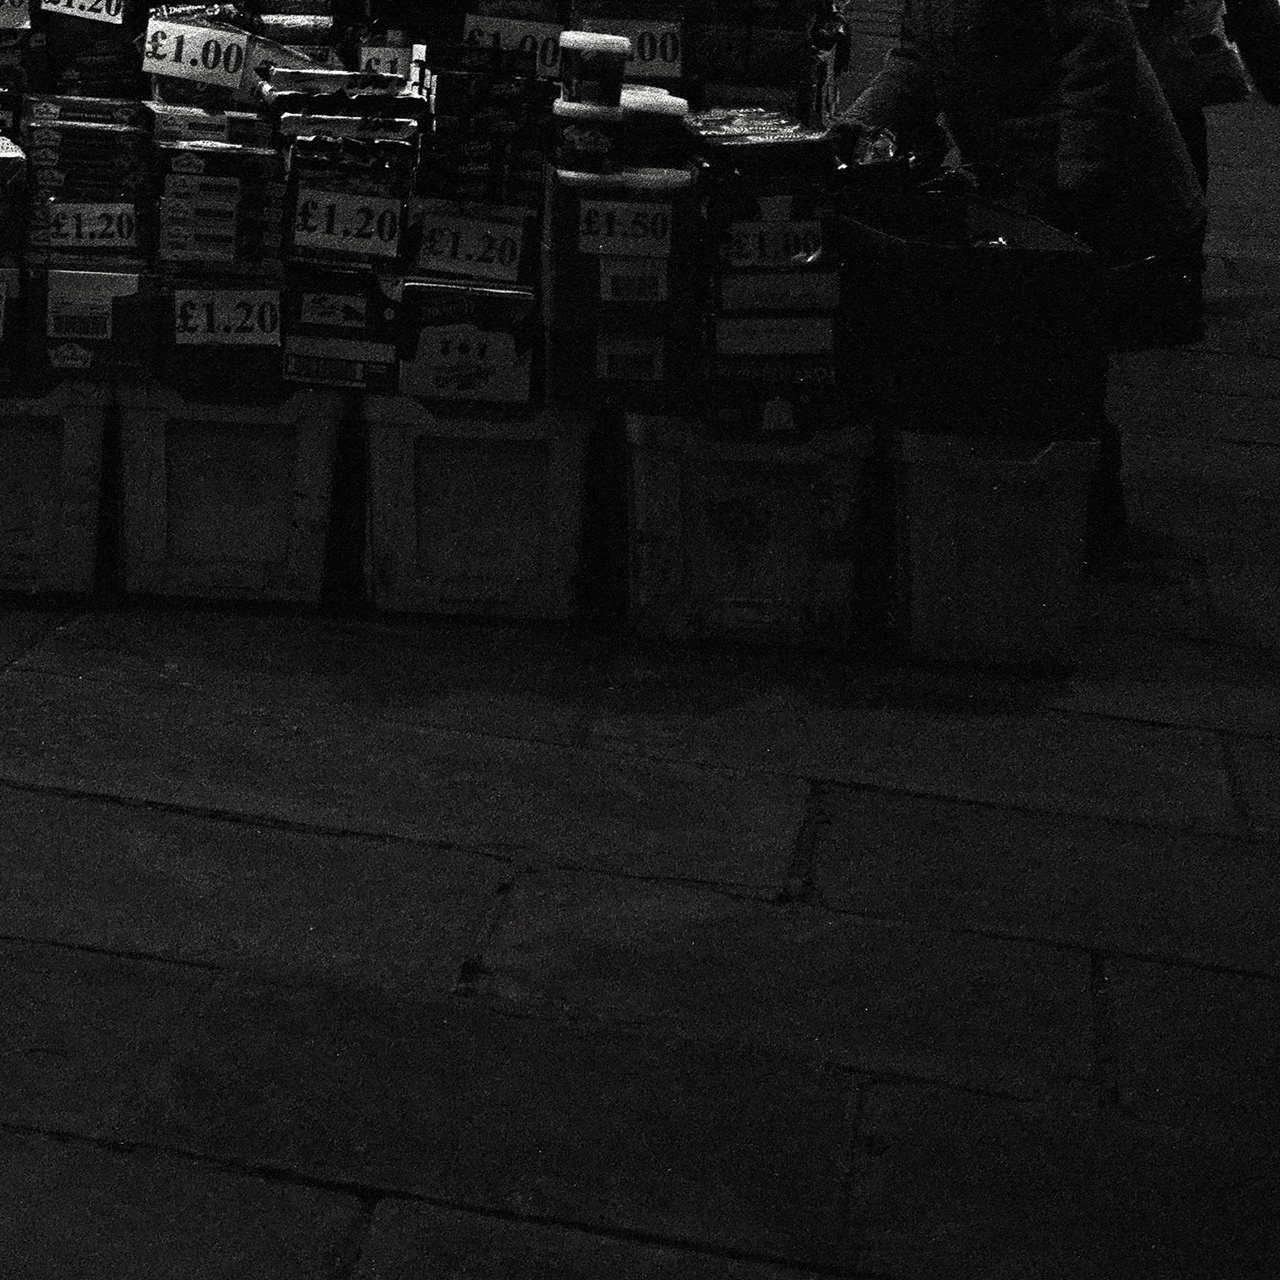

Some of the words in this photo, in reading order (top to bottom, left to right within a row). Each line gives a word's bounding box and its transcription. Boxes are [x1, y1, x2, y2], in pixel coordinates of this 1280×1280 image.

[145, 30, 242, 74] £1.00
[51, 211, 135, 240] £1.20
[296, 199, 398, 241] £1.20
[177, 301, 279, 335] £1.20
